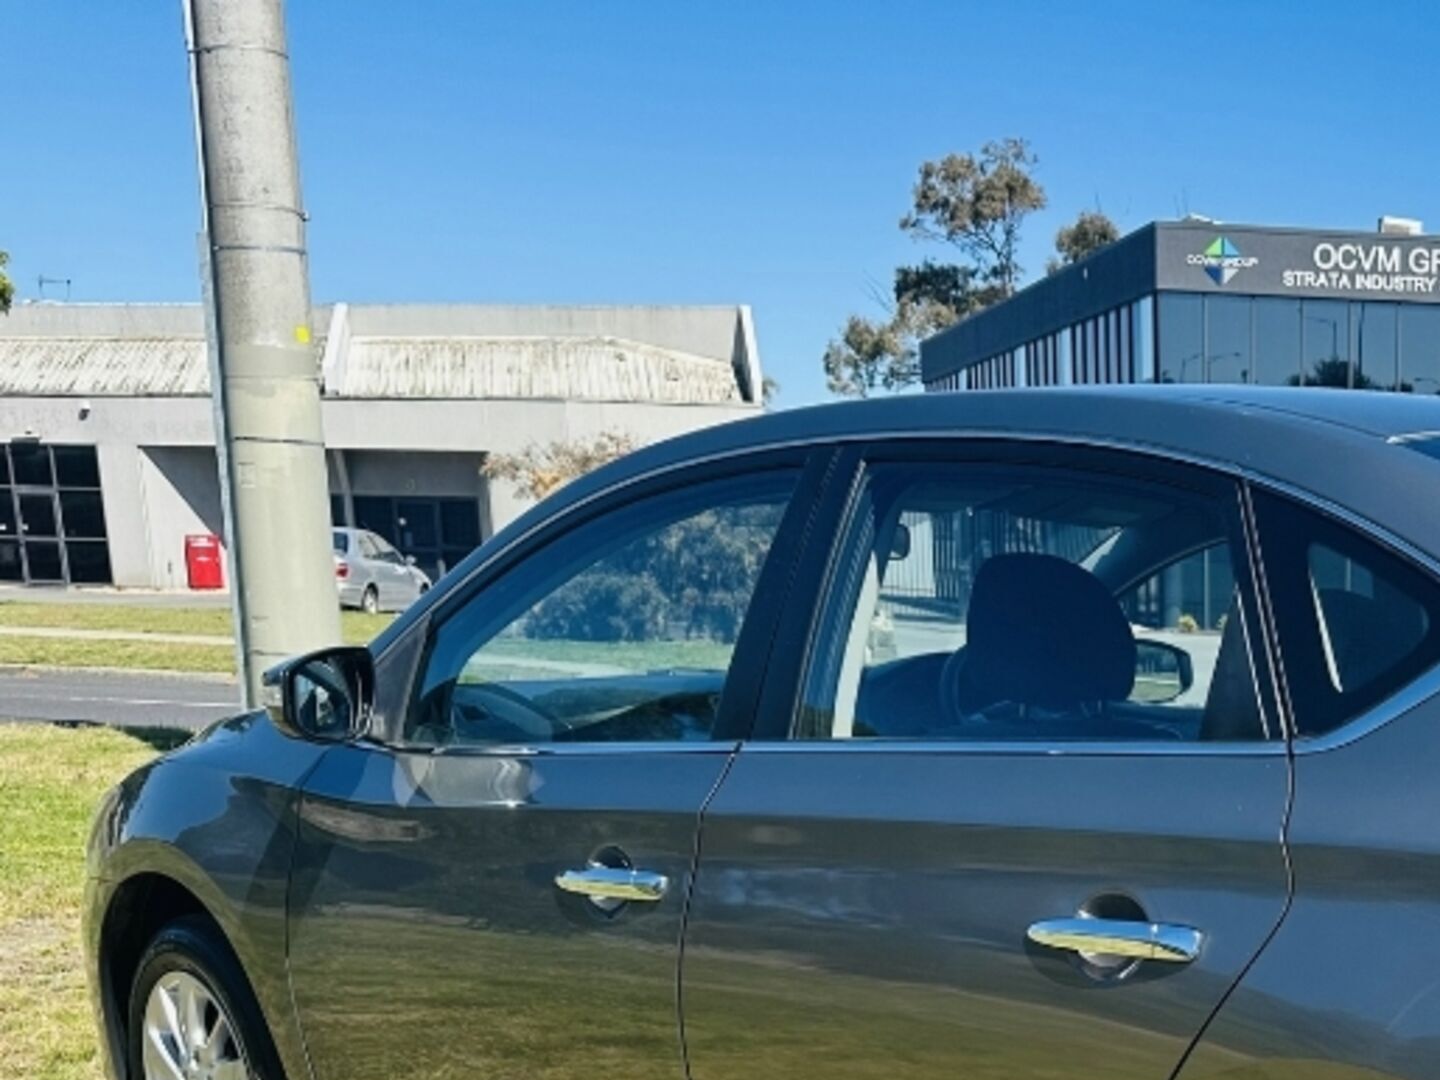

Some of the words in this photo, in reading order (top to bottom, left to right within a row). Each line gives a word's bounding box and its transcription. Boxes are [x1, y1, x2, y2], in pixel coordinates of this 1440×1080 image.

[1313, 243, 1401, 272] OCVM
[1282, 270, 1351, 289] STRATA
[1355, 273, 1436, 293] INDUSTRY
